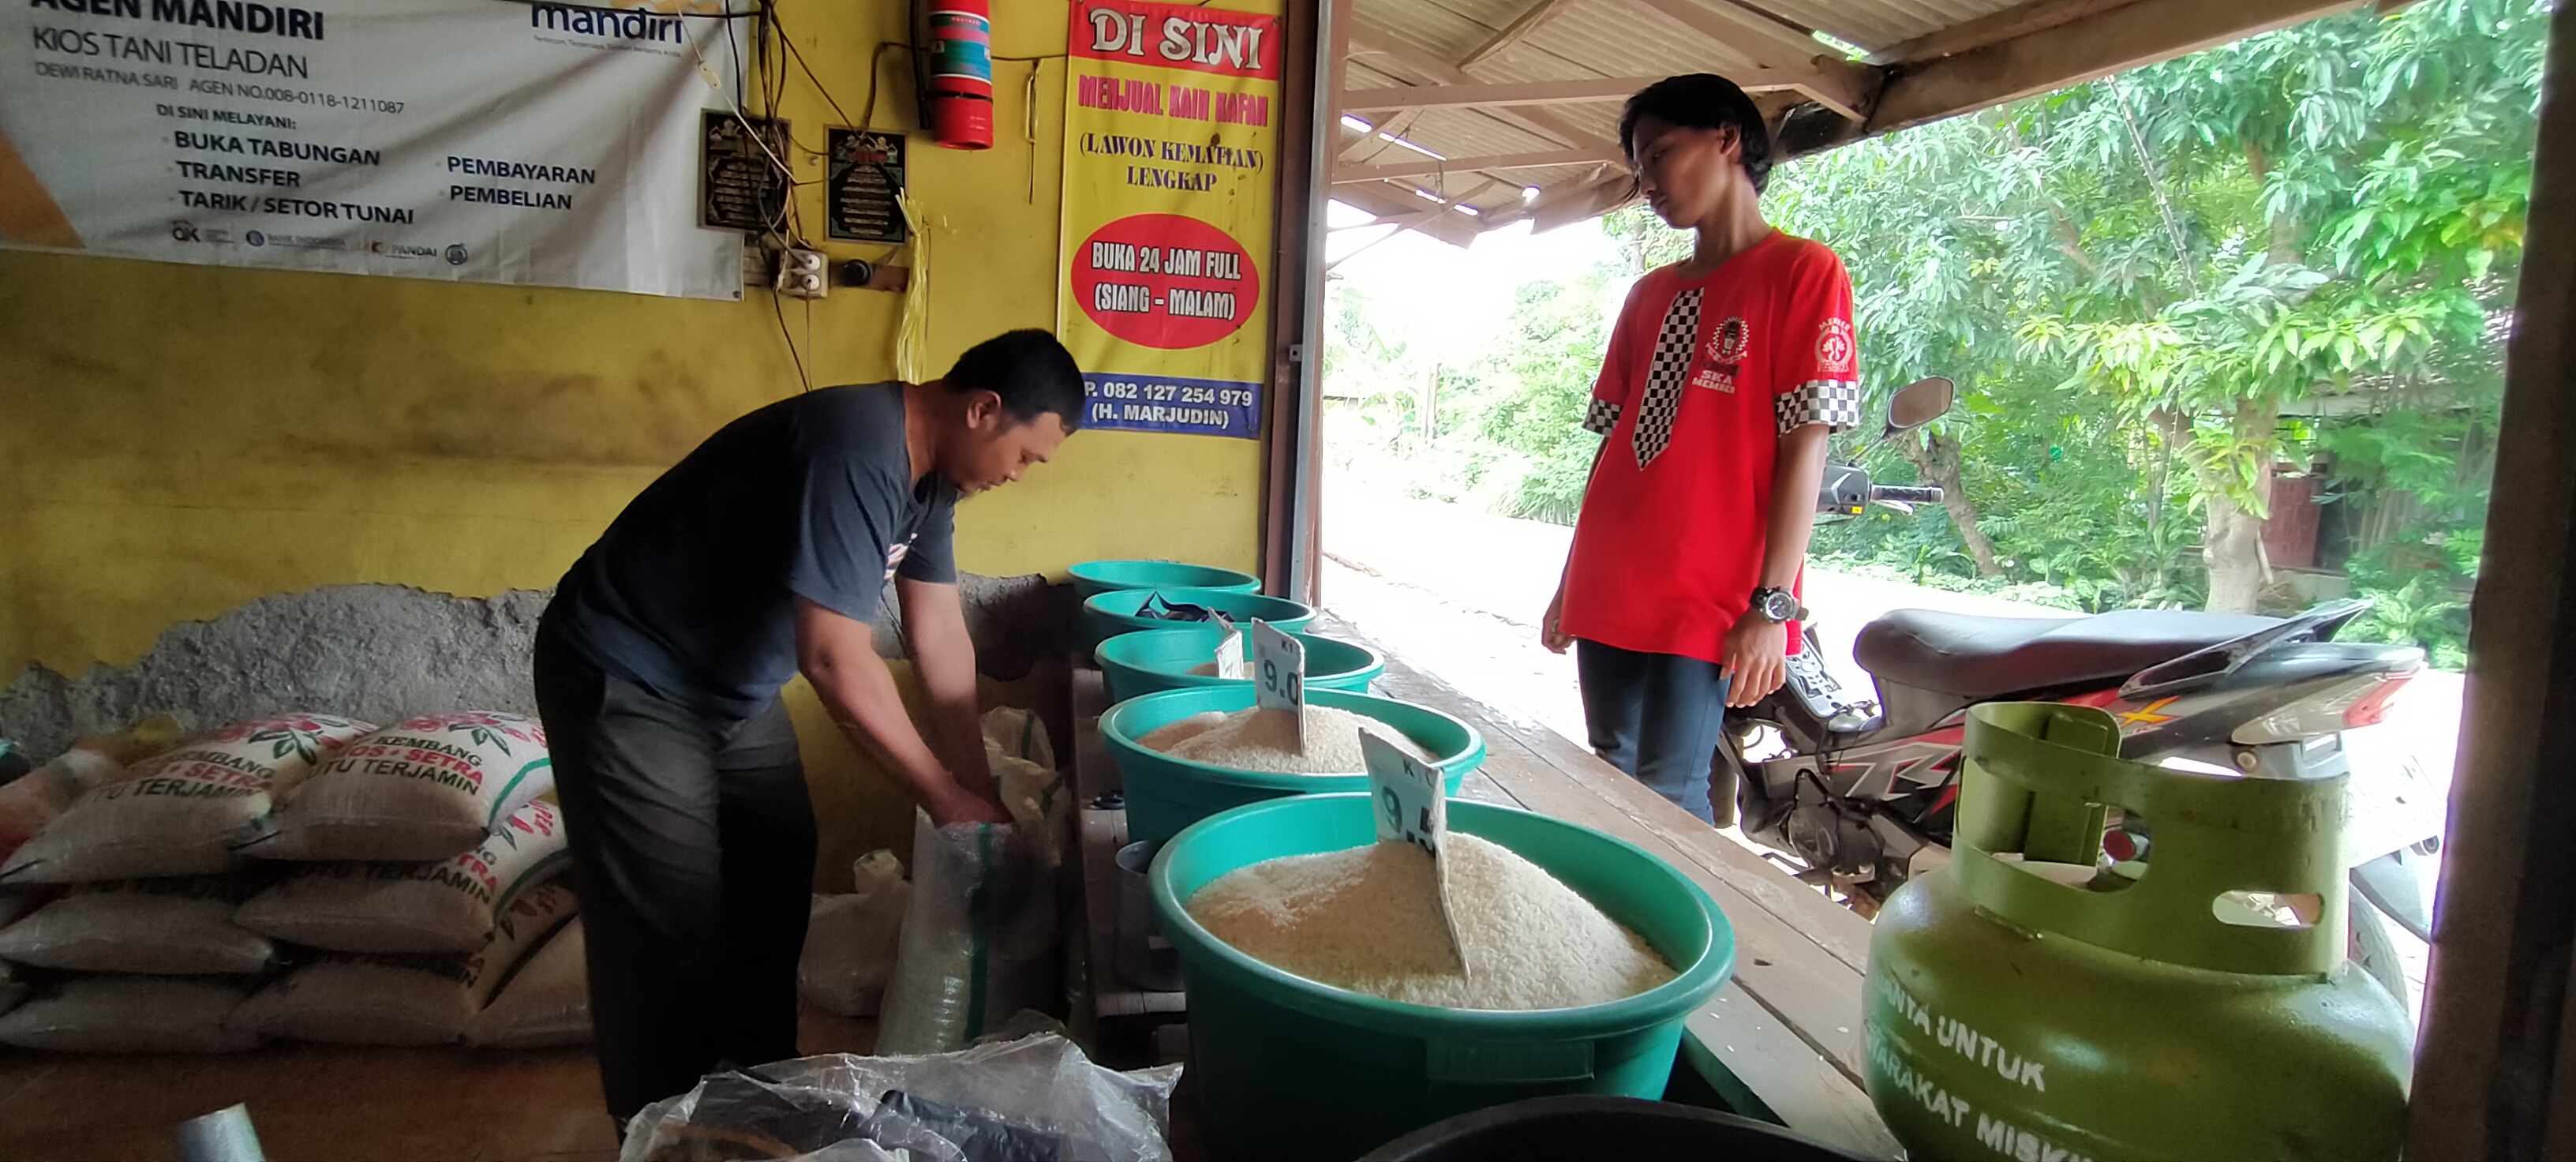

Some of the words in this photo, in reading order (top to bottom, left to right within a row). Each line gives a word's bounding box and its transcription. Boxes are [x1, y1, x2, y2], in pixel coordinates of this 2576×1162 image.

[152, 0, 324, 40] MANDIRI
[531, 4, 683, 44] mandiri
[1089, 7, 1147, 56] DI
[1159, 17, 1263, 69] SINI
[32, 25, 99, 56] KIOS
[103, 33, 171, 65] TANI
[174, 41, 308, 79] TELADAN
[36, 61, 79, 78] DEWI
[83, 66, 140, 86] RATNA
[143, 73, 178, 90] SARI
[189, 79, 234, 96] AGEN
[156, 103, 174, 118] DI
[177, 106, 209, 121] SINI
[212, 110, 297, 130] MELAYANI:
[1078, 73, 1163, 116] MENJUAL
[1168, 84, 1211, 122] KAIN
[1215, 92, 1269, 127] KAFAN
[174, 130, 245, 155] BUKA
[246, 137, 381, 167] TABUNGAN
[1080, 132, 1157, 159] (LAWON
[176, 160, 301, 188] TRANSFER
[447, 156, 596, 185] PEMBAYARAN
[1126, 165, 1218, 193] LENGKAP
[178, 189, 247, 213] TARIK
[264, 197, 339, 219] SETOR
[341, 203, 414, 225] TUNAI
[450, 185, 572, 210] PEMBELIAN
[1091, 241, 1136, 272] BUKA
[1140, 246, 1161, 274] 24
[1164, 248, 1202, 277] JAM
[1205, 251, 1242, 280] FULL
[1094, 282, 1150, 313] (SIANG
[1169, 288, 1236, 321] MALAM)
[1103, 381, 1138, 399] 082
[1144, 384, 1178, 401] 127
[1181, 386, 1215, 404] 254
[1219, 389, 1252, 407] 979
[1700, 369, 1733, 385] SKA
[1091, 403, 1118, 423] (H.
[1124, 403, 1230, 429] MARJUDIN)
[373, 736, 483, 767] KEMBANG
[404, 748, 484, 785] SETRA
[362, 759, 480, 796] TERJAMIN
[1936, 1015, 2046, 1093] UNTUK
